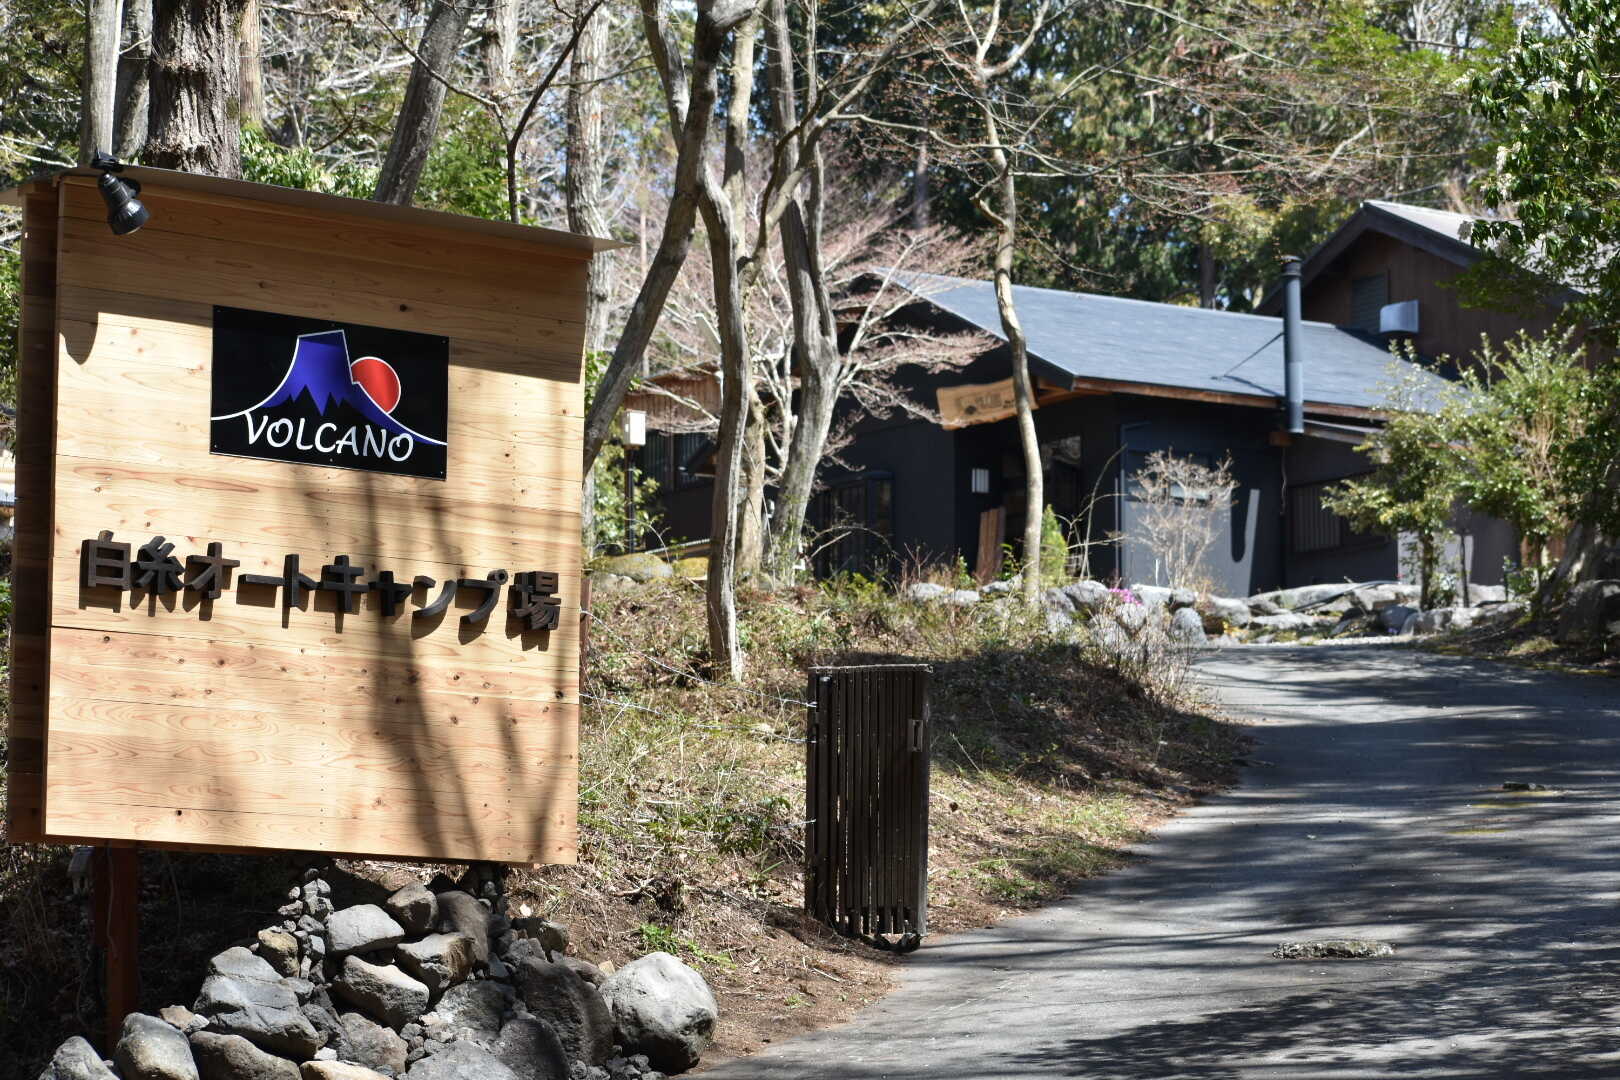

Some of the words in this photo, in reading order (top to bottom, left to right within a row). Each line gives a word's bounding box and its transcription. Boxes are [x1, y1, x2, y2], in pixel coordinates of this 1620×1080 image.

[244, 411, 414, 462] VOLCANO
[81, 530, 562, 630] 白糸オートキャンプ場
